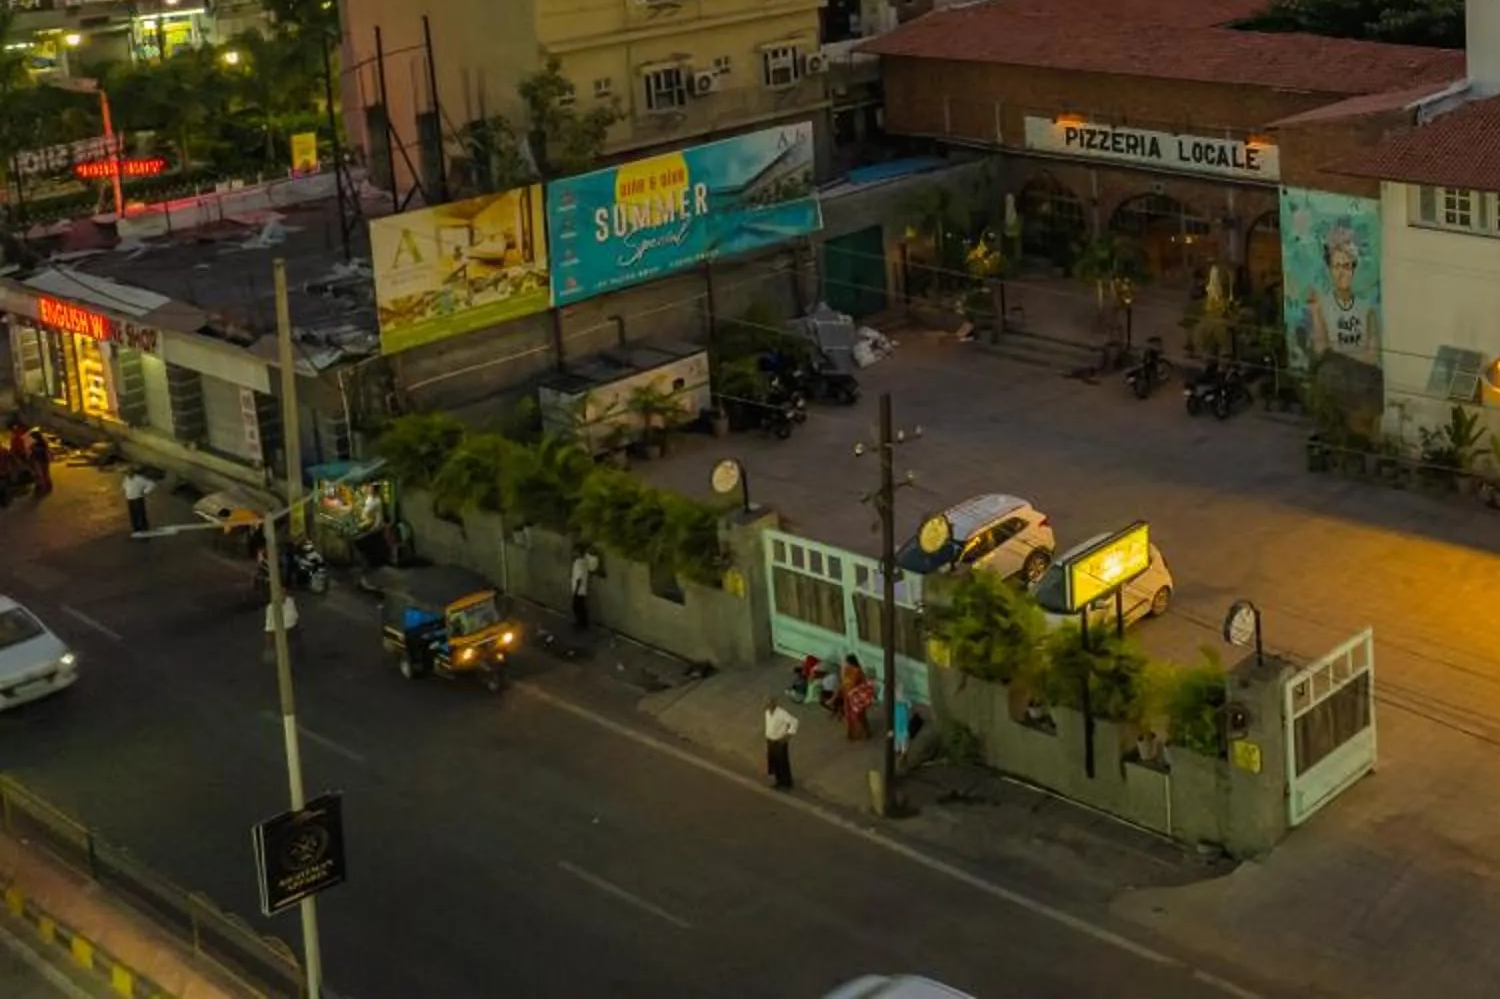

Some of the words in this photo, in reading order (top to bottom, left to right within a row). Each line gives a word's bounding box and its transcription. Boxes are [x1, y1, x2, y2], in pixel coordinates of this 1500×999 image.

[1064, 126, 1162, 159] PIZZERIA
[1178, 139, 1262, 171] LOCALE
[594, 181, 709, 243] SUMMER
[40, 297, 90, 335] ENGLISH
[90, 312, 123, 346] WNE
